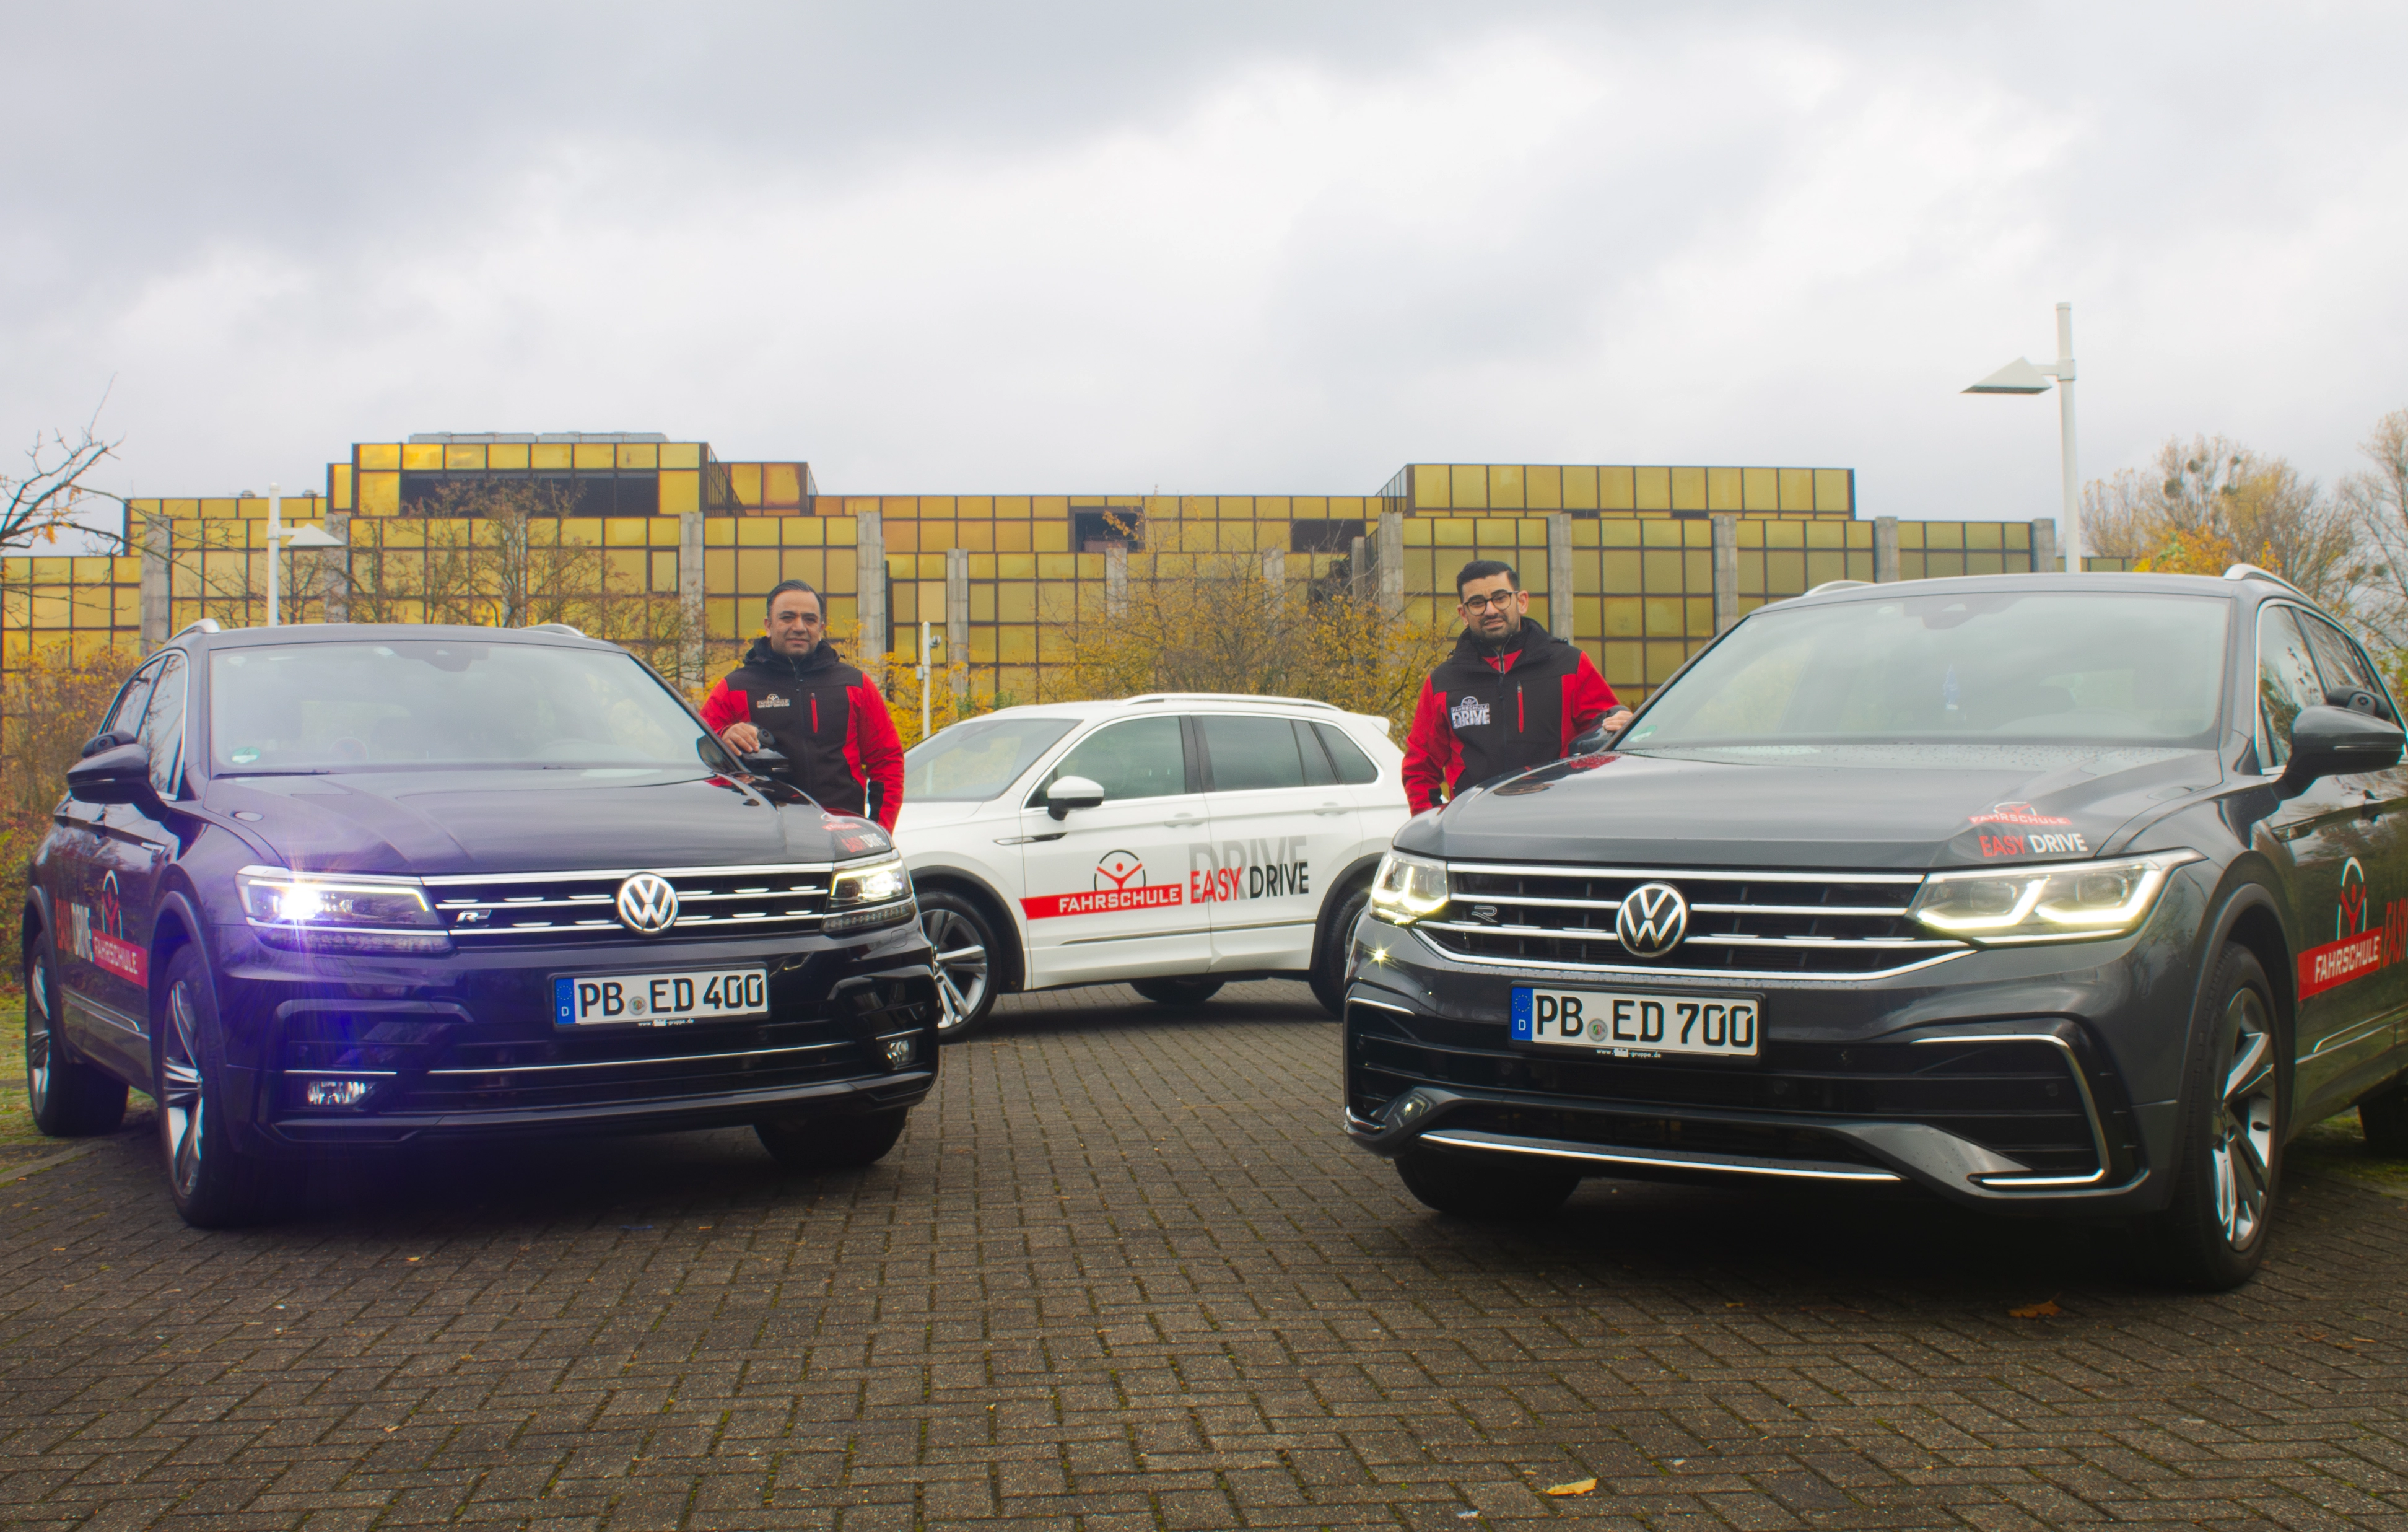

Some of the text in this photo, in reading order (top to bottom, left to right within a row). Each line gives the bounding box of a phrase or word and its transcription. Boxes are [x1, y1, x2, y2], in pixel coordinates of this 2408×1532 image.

[1452, 709, 1490, 729] DRIVE
[1971, 813, 2067, 824] FAHRSCHULE
[1979, 833, 2088, 857] EASY DRIVE
[1190, 862, 1309, 904] EASY DRIVE
[1059, 888, 1179, 913] FAHRSCHULE
[2314, 936, 2380, 984] FAHRSCHULE
[578, 974, 764, 1017] PB ED 400
[561, 1006, 569, 1017] D
[1535, 994, 1754, 1048] PB ED 700
[1518, 1019, 1526, 1031] D
